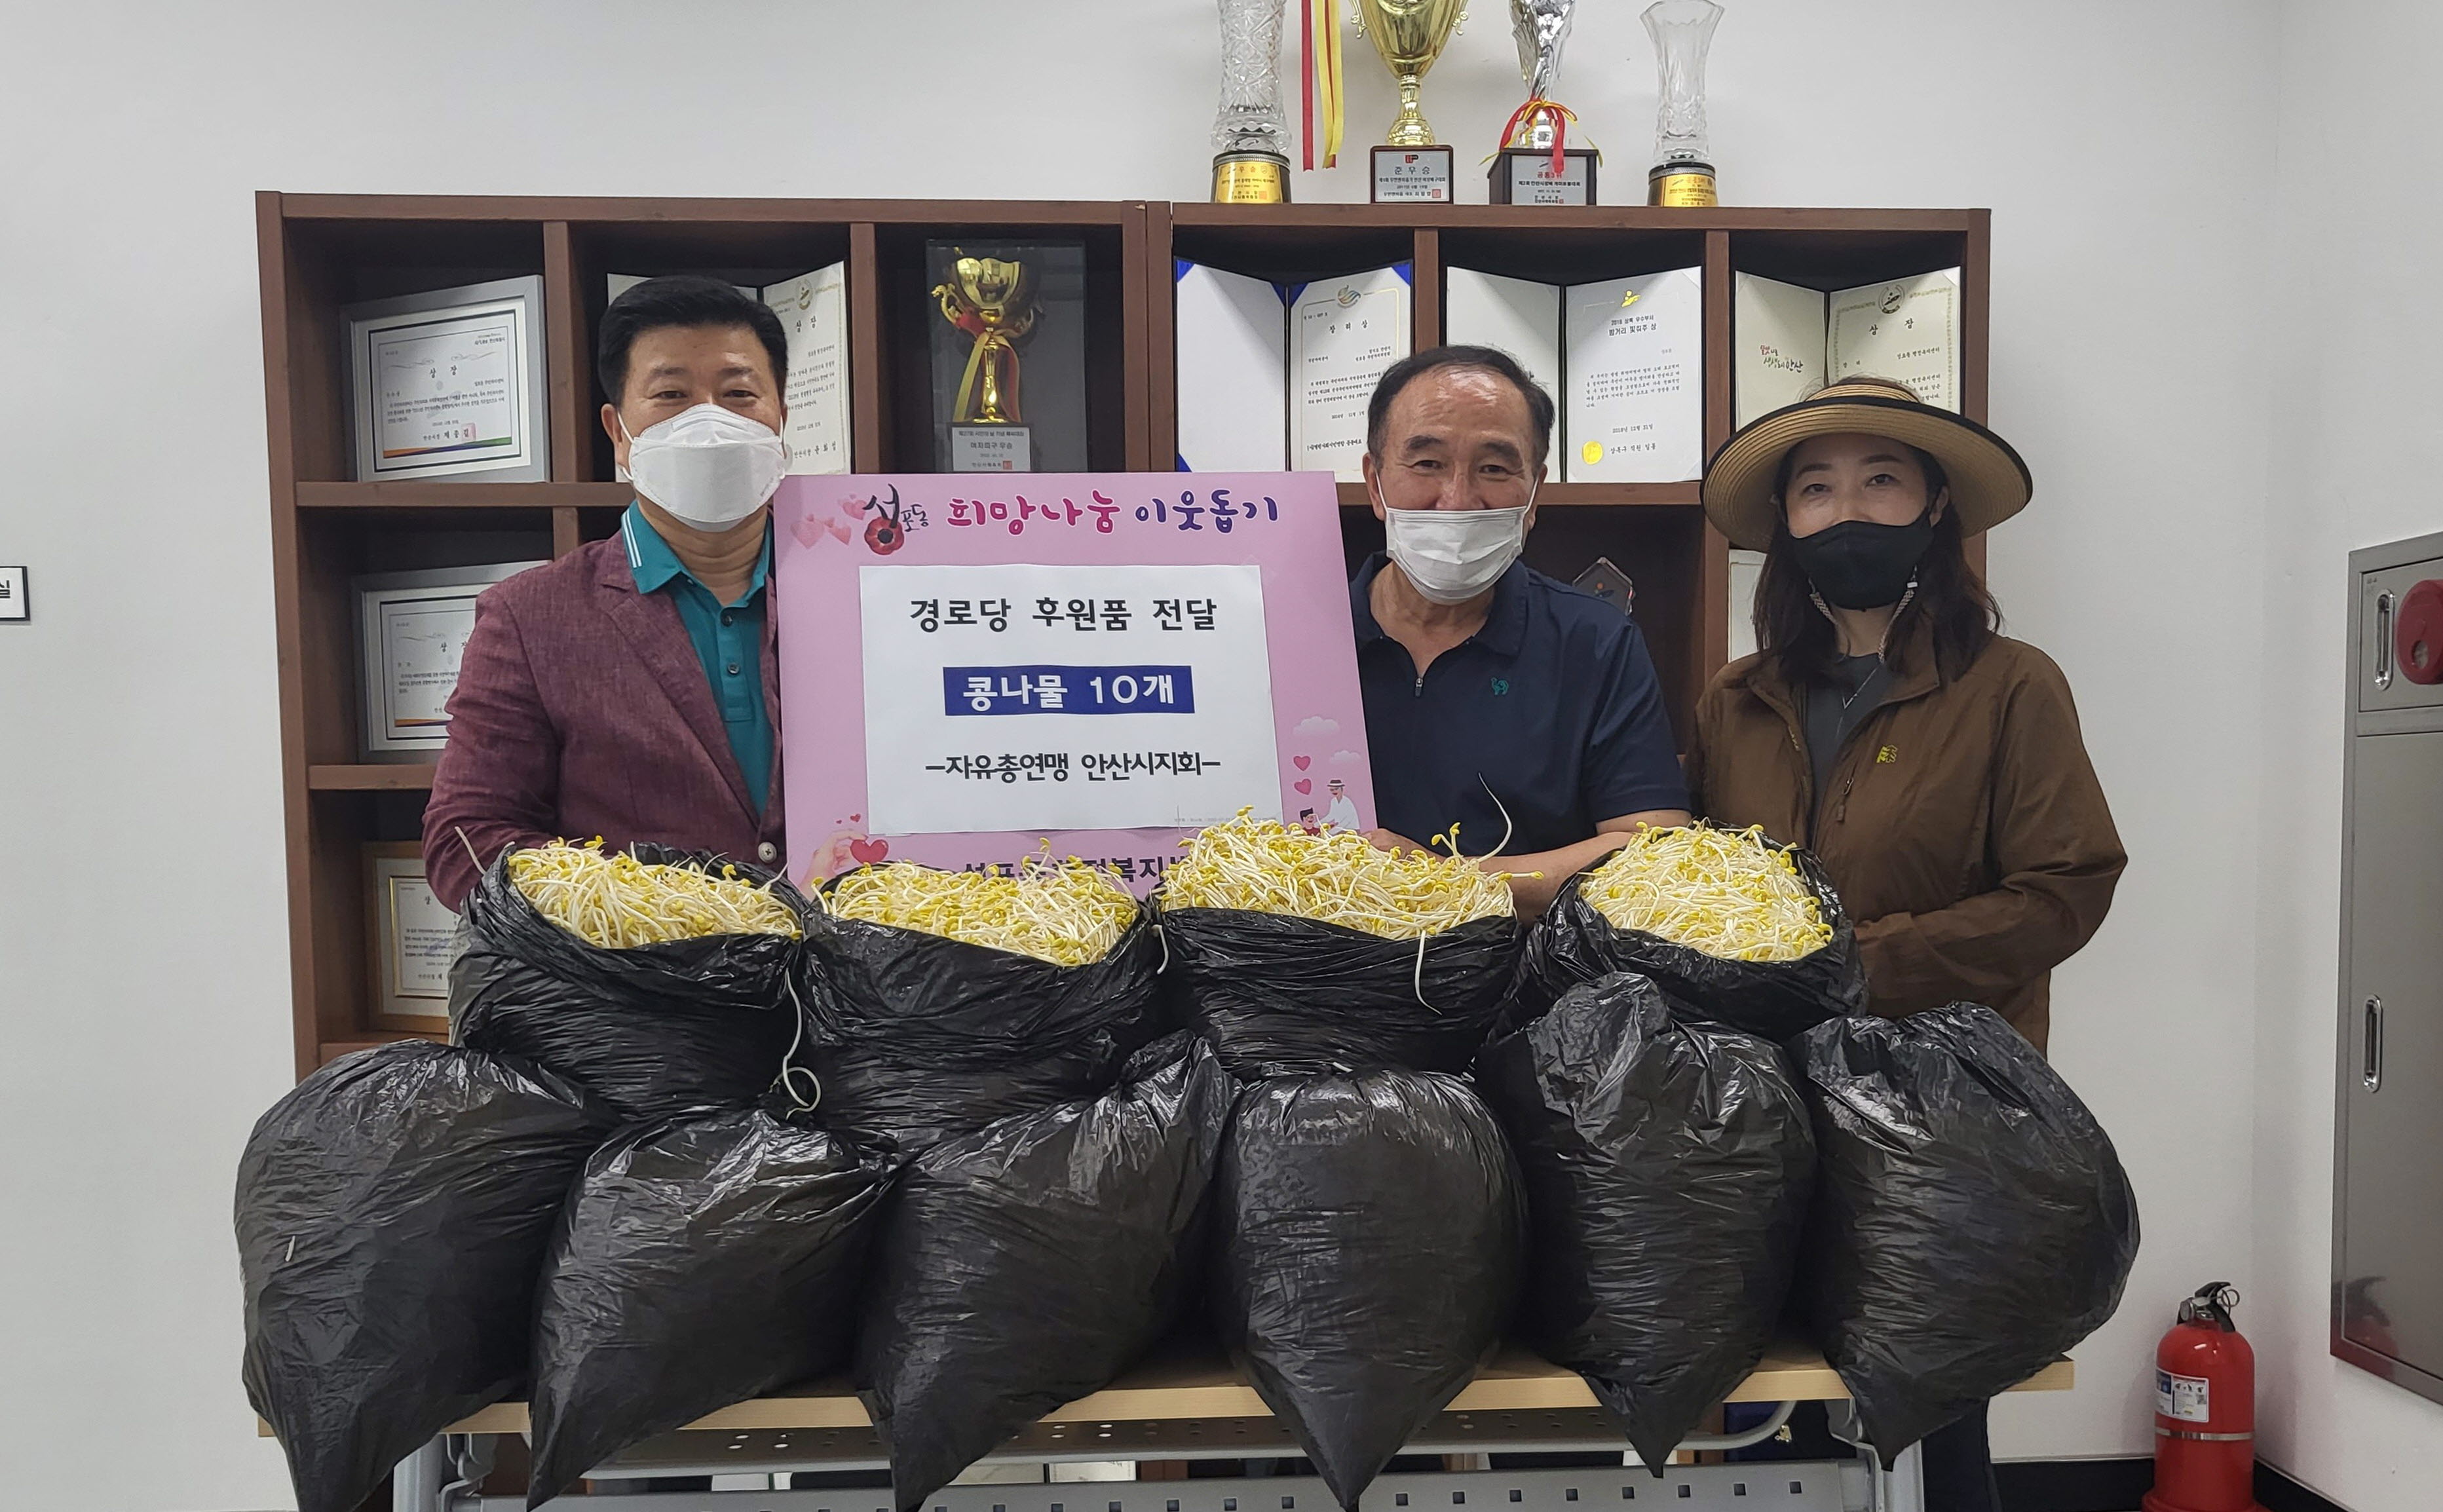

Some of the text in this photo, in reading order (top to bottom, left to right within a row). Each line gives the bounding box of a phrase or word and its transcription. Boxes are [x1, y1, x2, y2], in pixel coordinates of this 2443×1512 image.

[947, 490, 1122, 536] 희망나눔
[1134, 489, 1279, 534] 이웃돕기
[911, 597, 1217, 633] 경로당 후원품 전달
[963, 673, 1174, 711] 콩나물 10개
